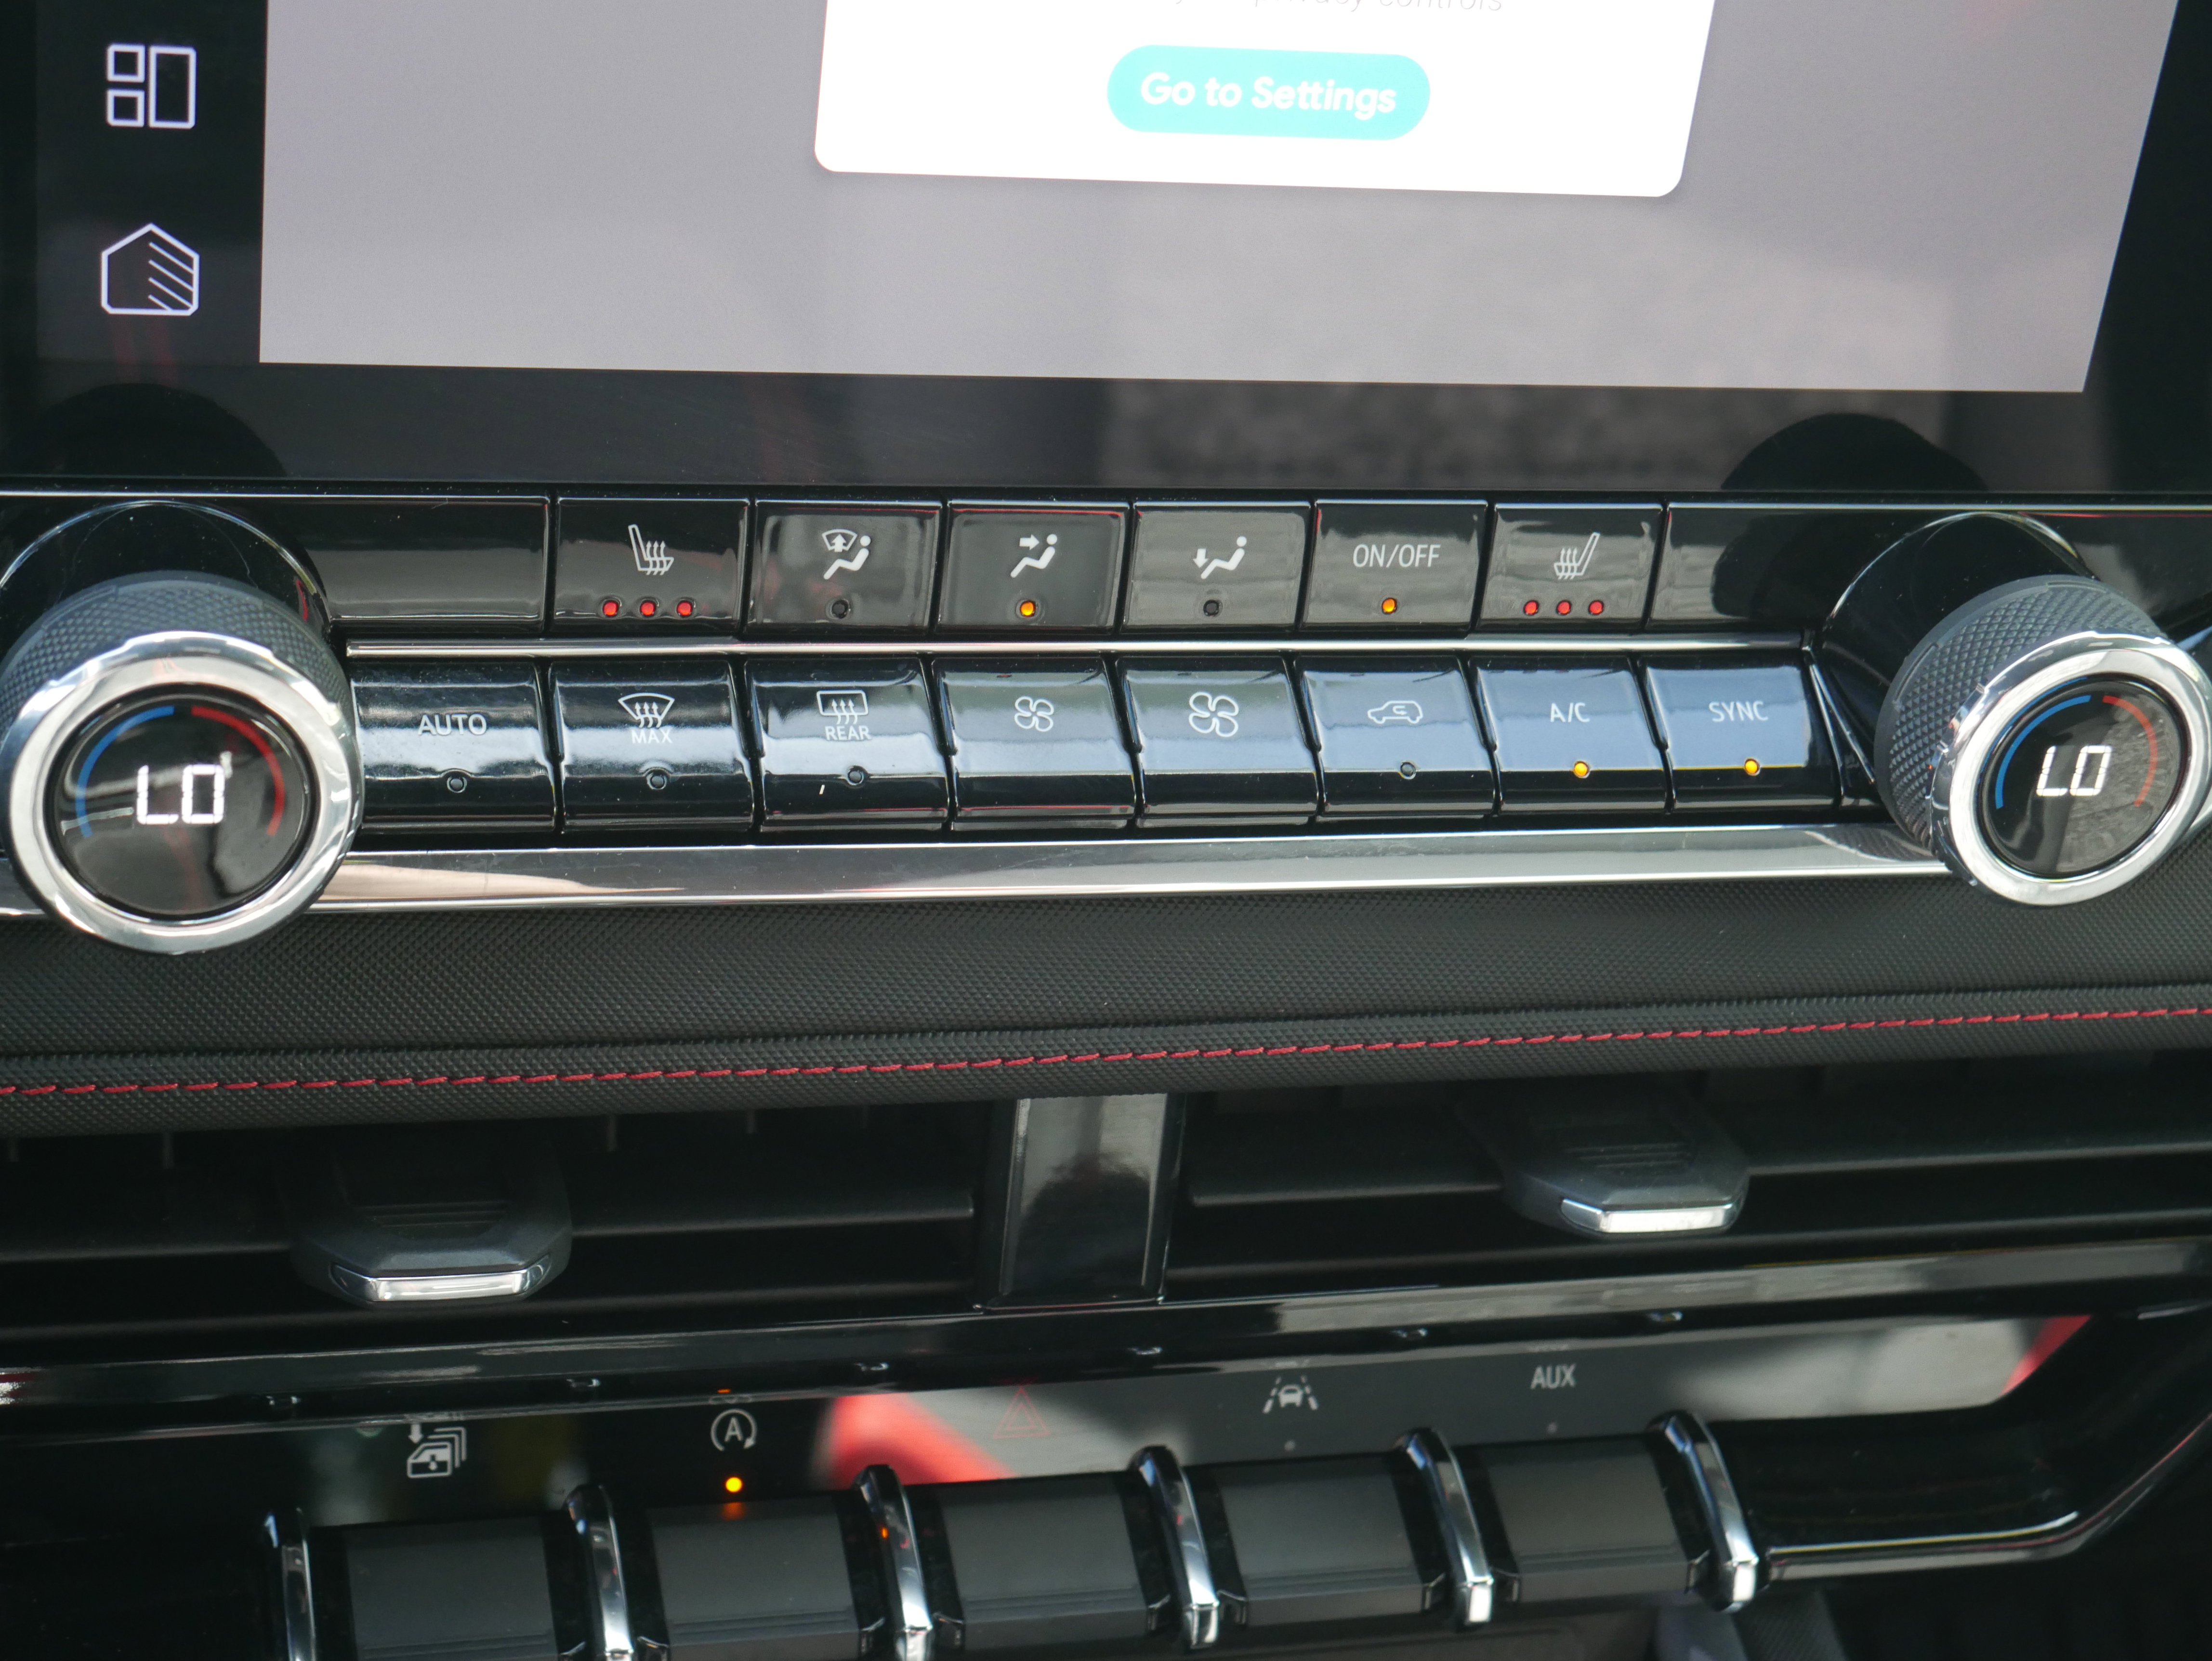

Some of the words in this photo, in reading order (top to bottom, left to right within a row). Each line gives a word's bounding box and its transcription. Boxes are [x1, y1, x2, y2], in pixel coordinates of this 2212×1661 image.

[1141, 71, 1196, 105] Go
[1205, 77, 1242, 107] to
[1251, 76, 1396, 120] Settings
[1353, 544, 1441, 568] ON/OFF
[1550, 702, 1590, 723] A/C
[1708, 700, 1769, 722] SYNC
[418, 714, 487, 736] AUTO
[825, 725, 871, 741] REAR
[631, 729, 673, 744] MAX
[1530, 1363, 1577, 1389] AUX
